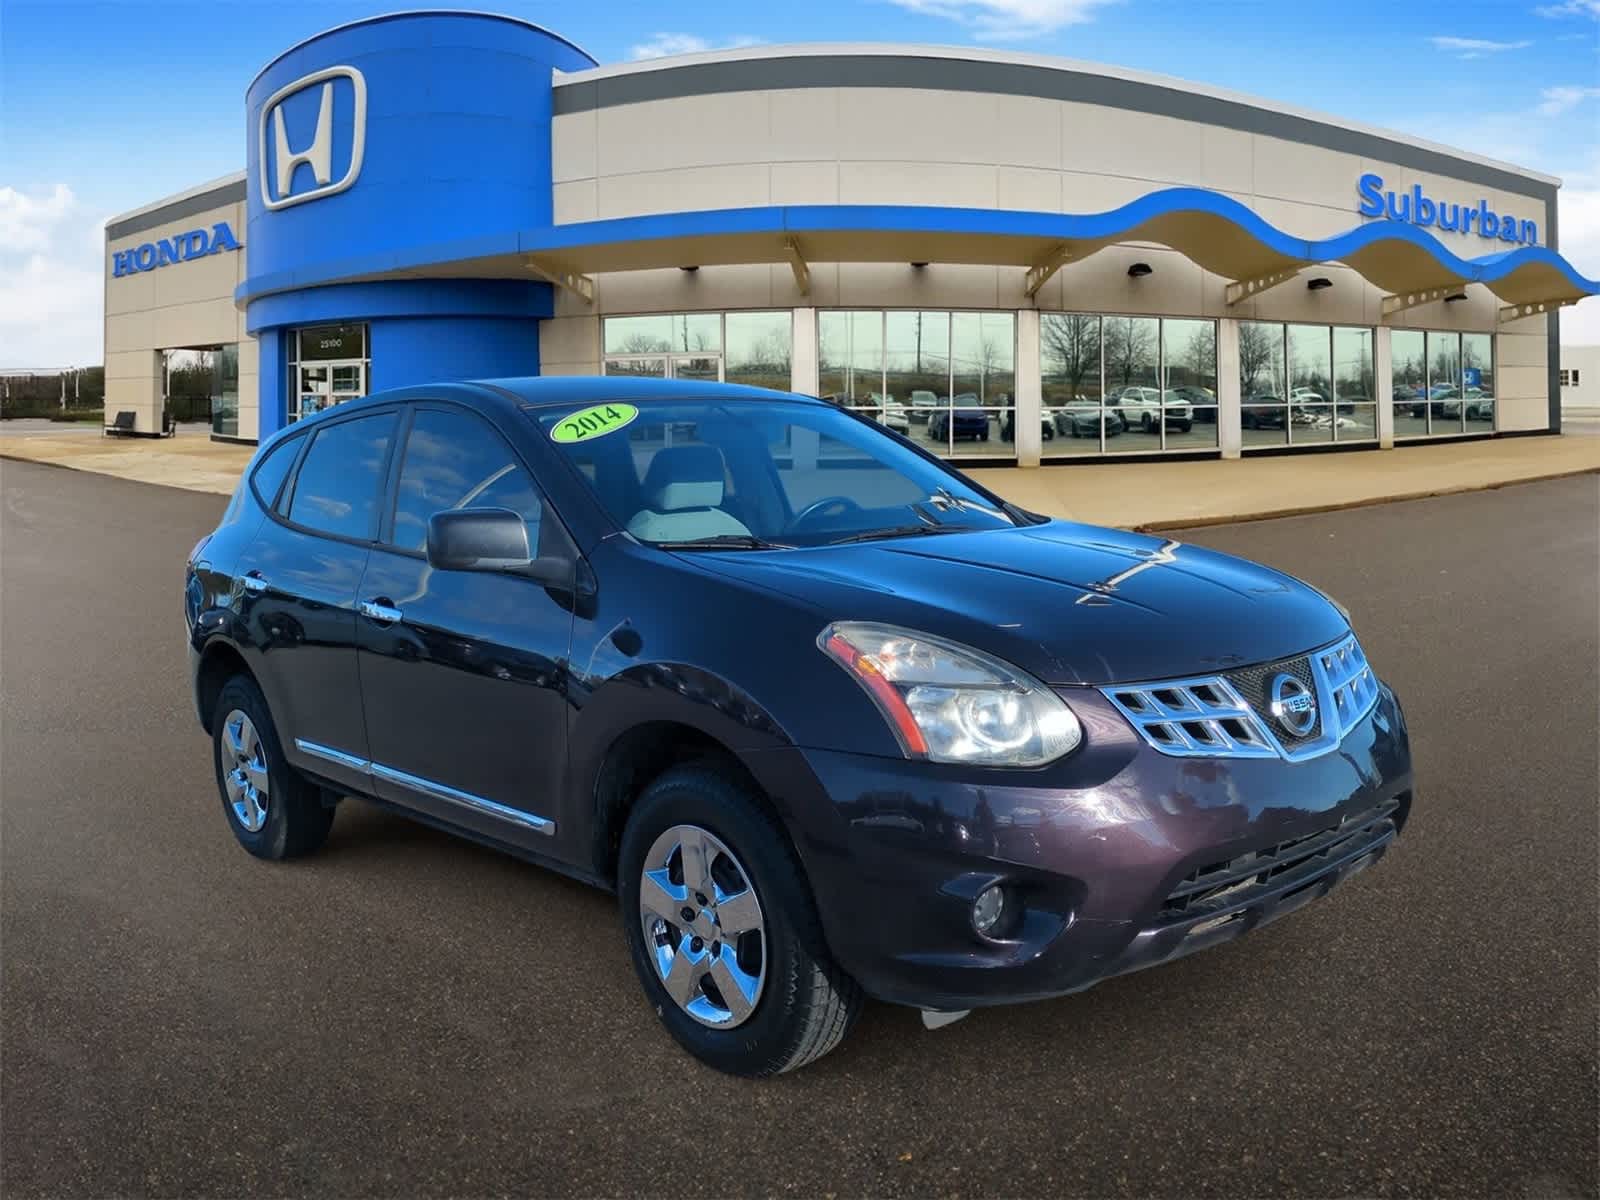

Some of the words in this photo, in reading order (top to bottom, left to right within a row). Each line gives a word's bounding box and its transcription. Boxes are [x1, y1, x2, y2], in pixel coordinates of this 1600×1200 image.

[1358, 173, 1538, 246] Suburban
[112, 221, 241, 278] HONDA
[564, 406, 621, 438] 2014
